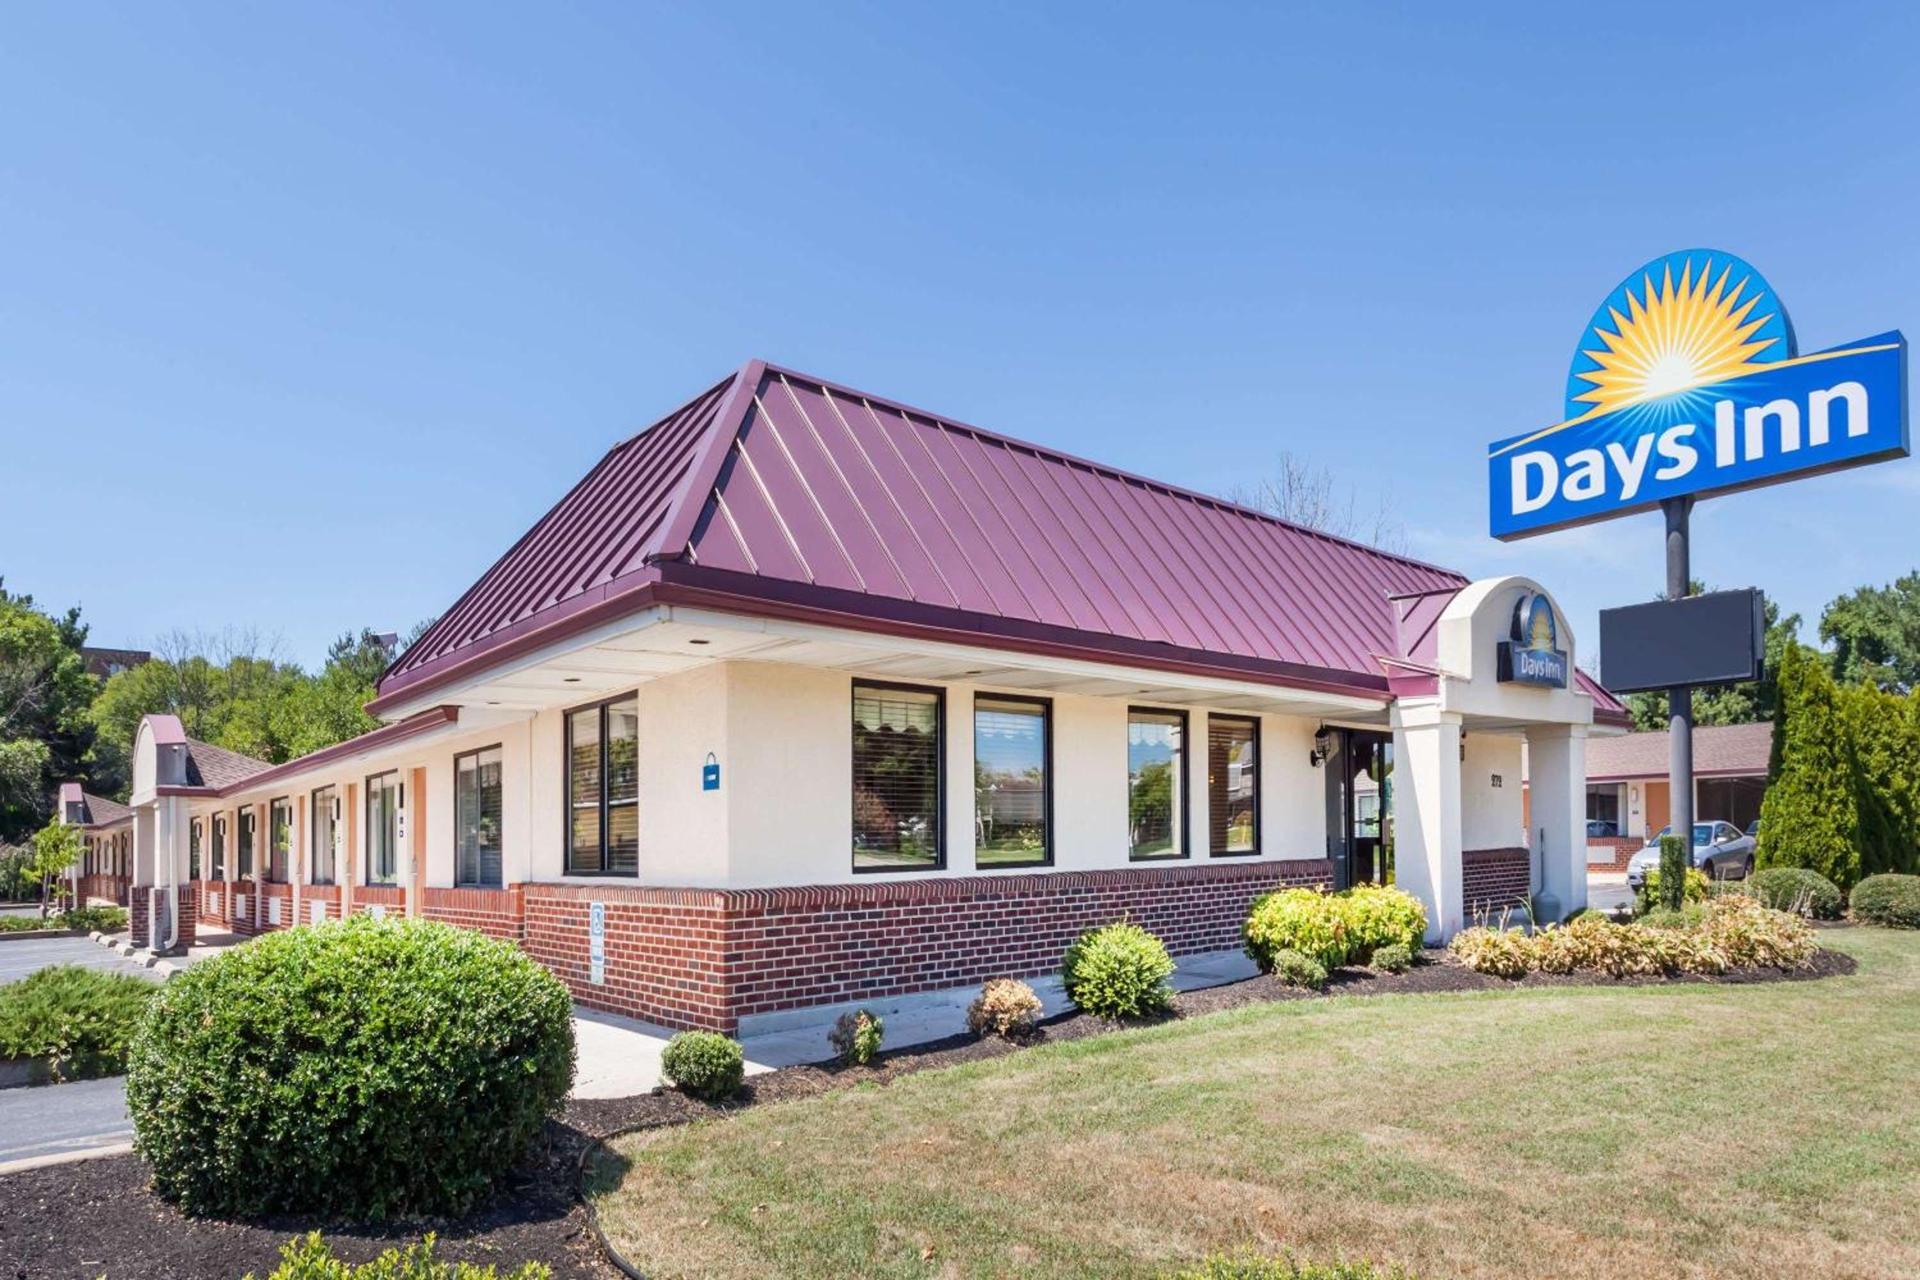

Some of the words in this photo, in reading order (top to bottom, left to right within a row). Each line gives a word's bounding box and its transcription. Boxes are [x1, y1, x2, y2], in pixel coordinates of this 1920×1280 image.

[1511, 424, 1698, 516] Days
[1715, 381, 1869, 469] Inn
[1521, 652, 1545, 678] Days
[1545, 656, 1560, 680] Inn
